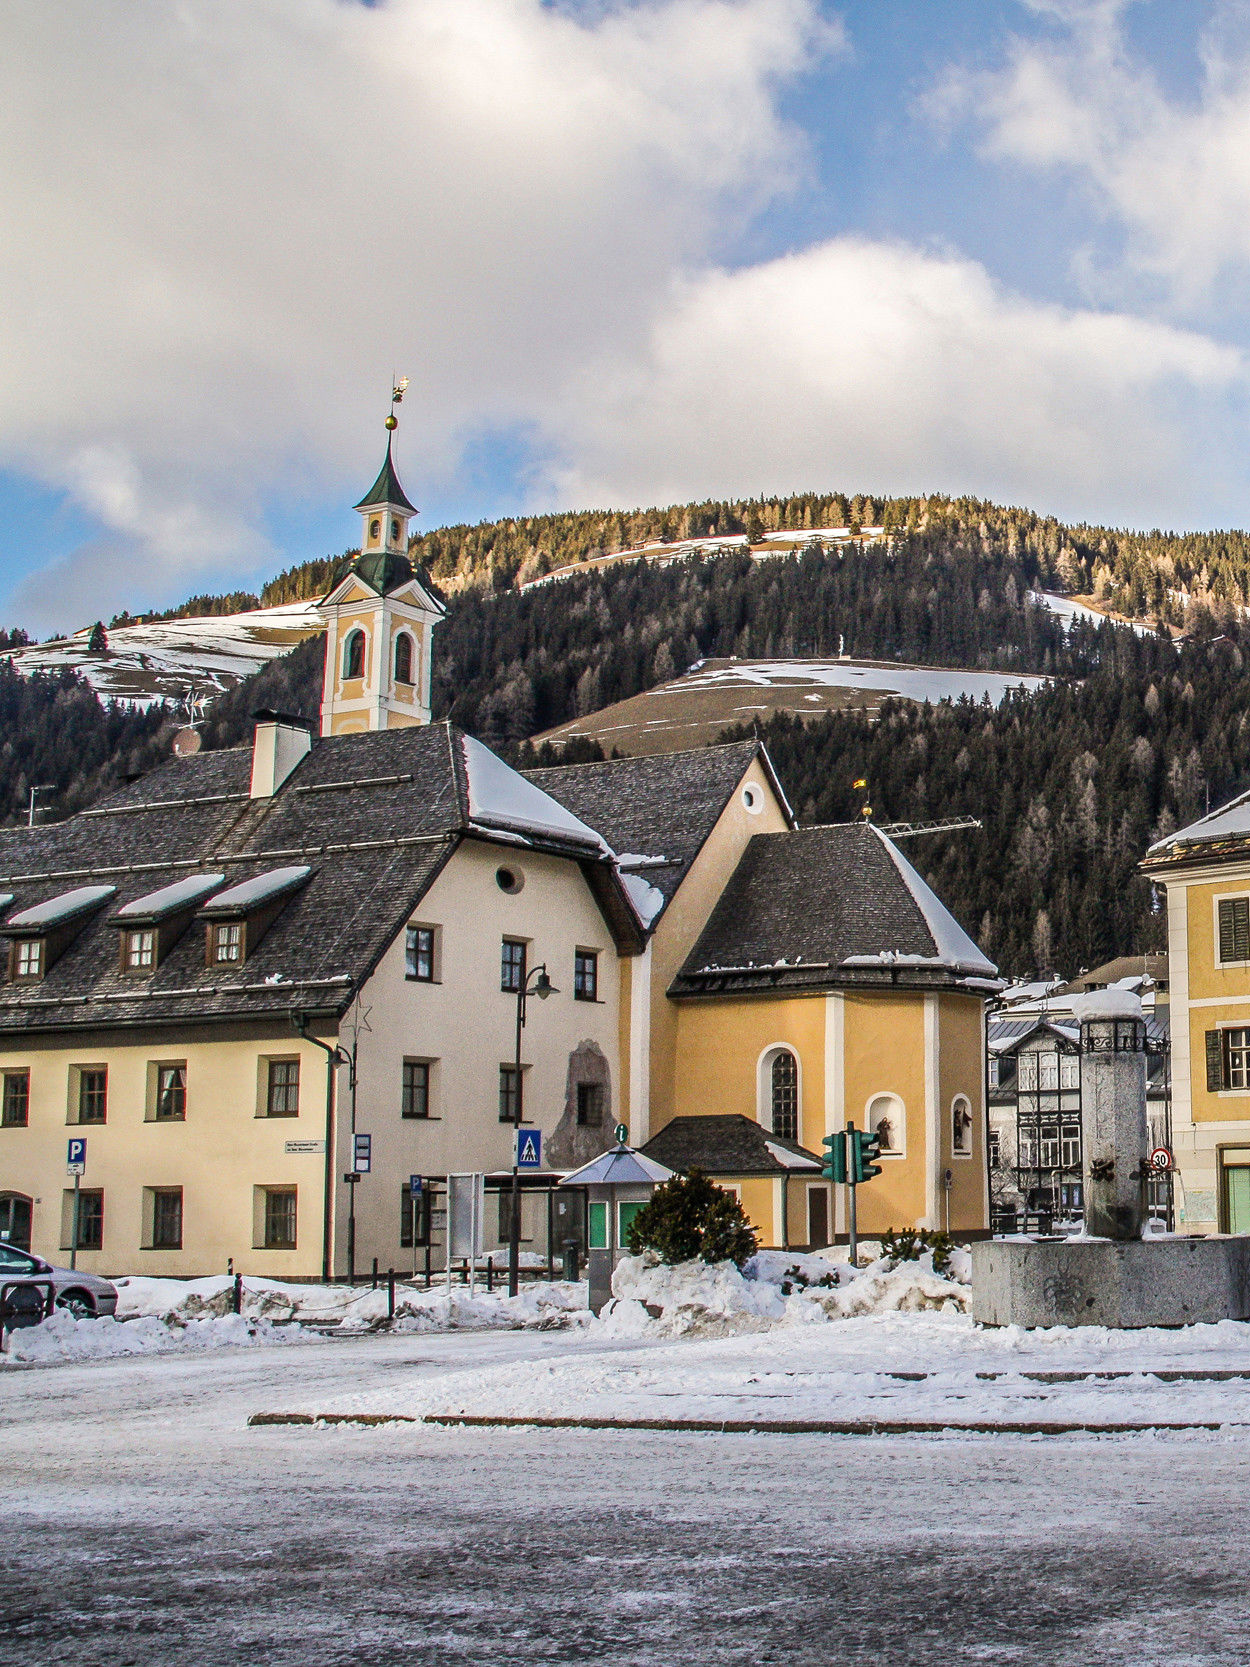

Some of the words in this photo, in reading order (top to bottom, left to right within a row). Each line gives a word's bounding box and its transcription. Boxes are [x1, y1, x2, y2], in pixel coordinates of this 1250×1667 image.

[71, 1141, 83, 1160] P
[1155, 1154, 1166, 1166] 30
[412, 1177, 420, 1190] P
